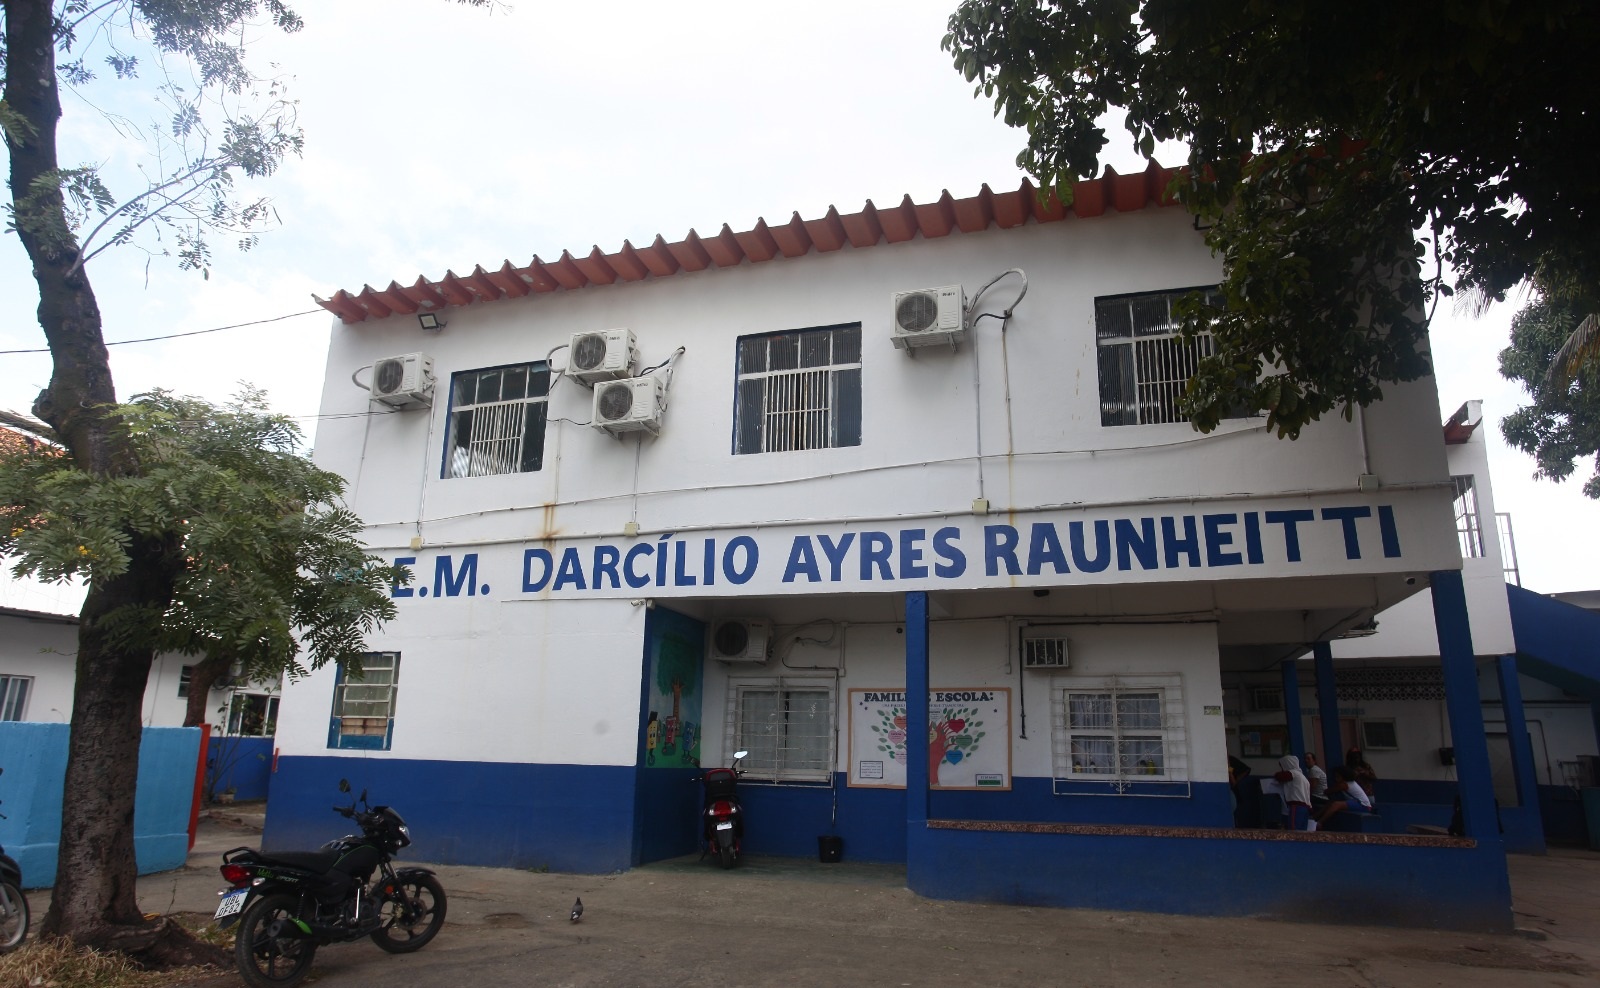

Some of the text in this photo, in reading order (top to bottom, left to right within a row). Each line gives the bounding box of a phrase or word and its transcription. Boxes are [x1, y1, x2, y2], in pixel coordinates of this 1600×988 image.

[391, 505, 1400, 598] E.M. DARCÍLIO AYRES RAUNHEITTI
[863, 692, 907, 702] FAMIL
[936, 691, 994, 702] ESCOLA:
